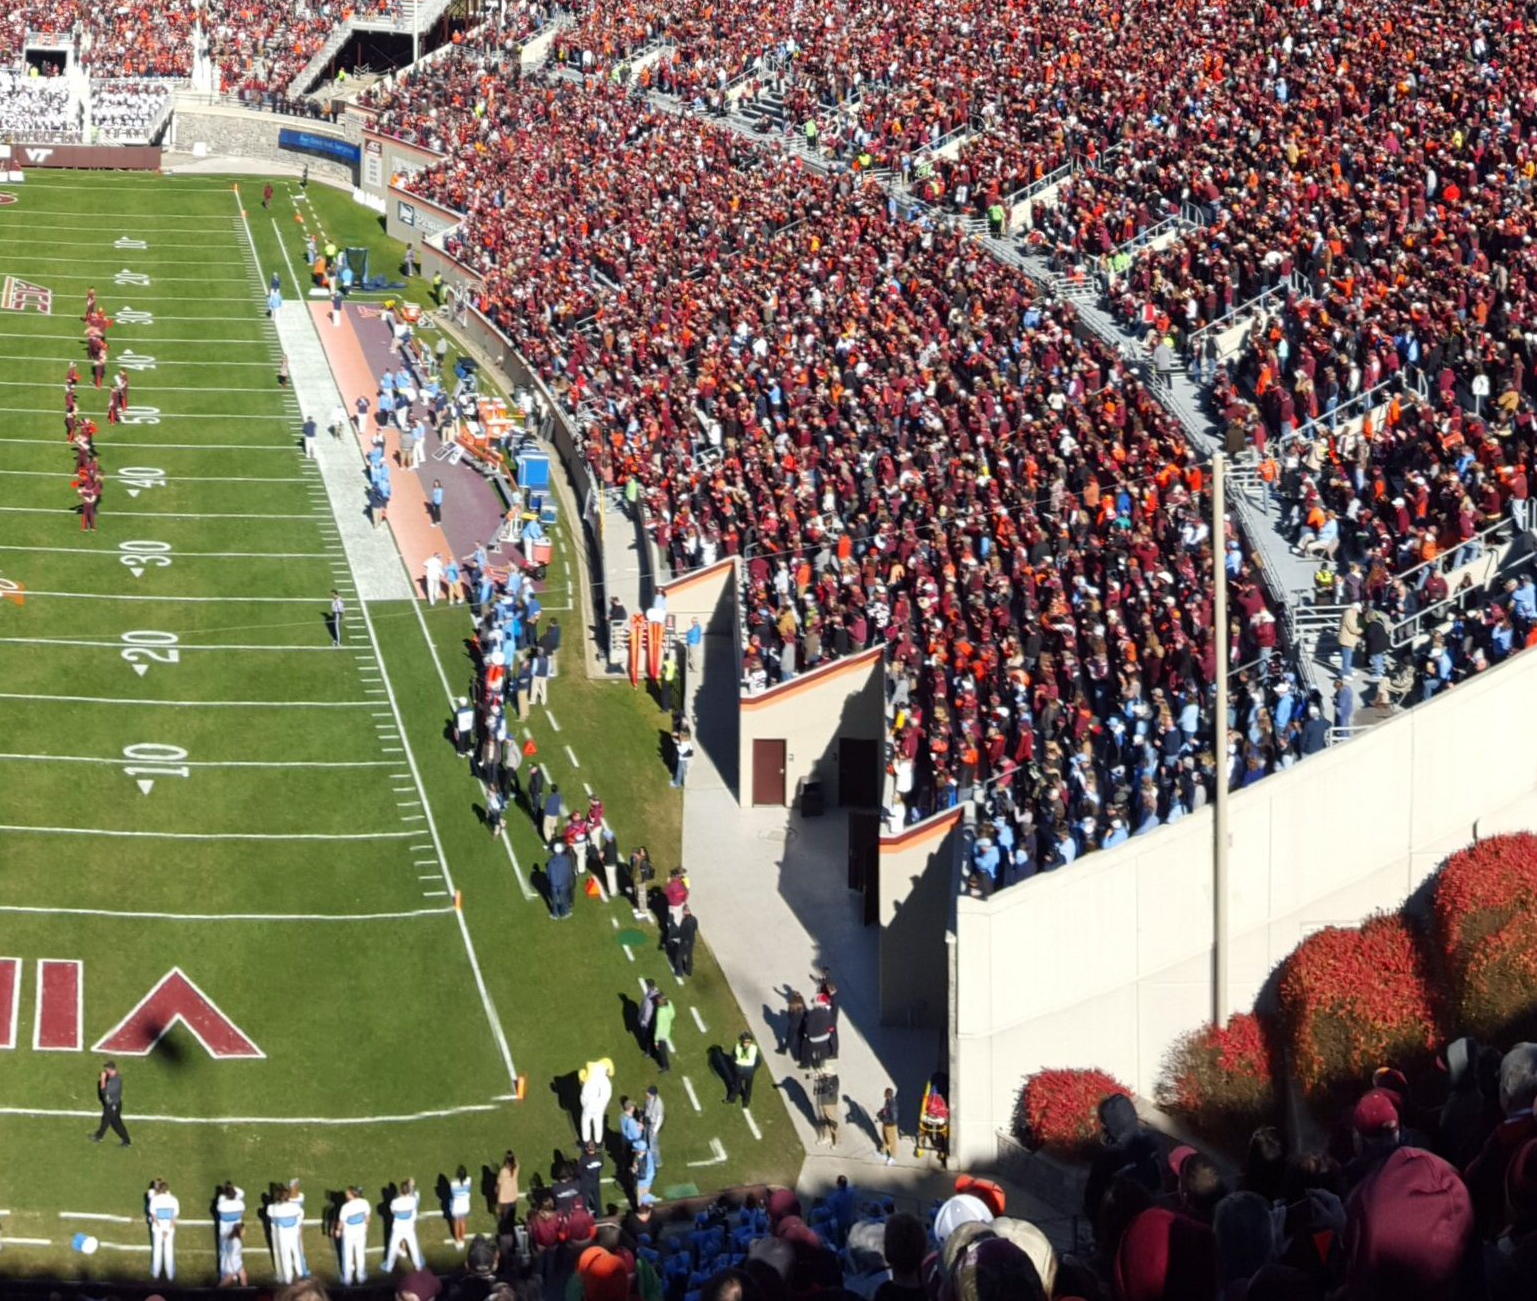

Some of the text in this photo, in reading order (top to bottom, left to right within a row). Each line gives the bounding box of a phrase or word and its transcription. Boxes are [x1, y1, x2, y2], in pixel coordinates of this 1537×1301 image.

[25, 148, 54, 162] VT
[114, 273, 150, 286] 20
[115, 310, 154, 325] 30
[116, 354, 157, 371] 40
[118, 465, 167, 489] 40
[118, 539, 172, 567] 30
[121, 629, 179, 664] 20
[122, 742, 189, 778] 10
